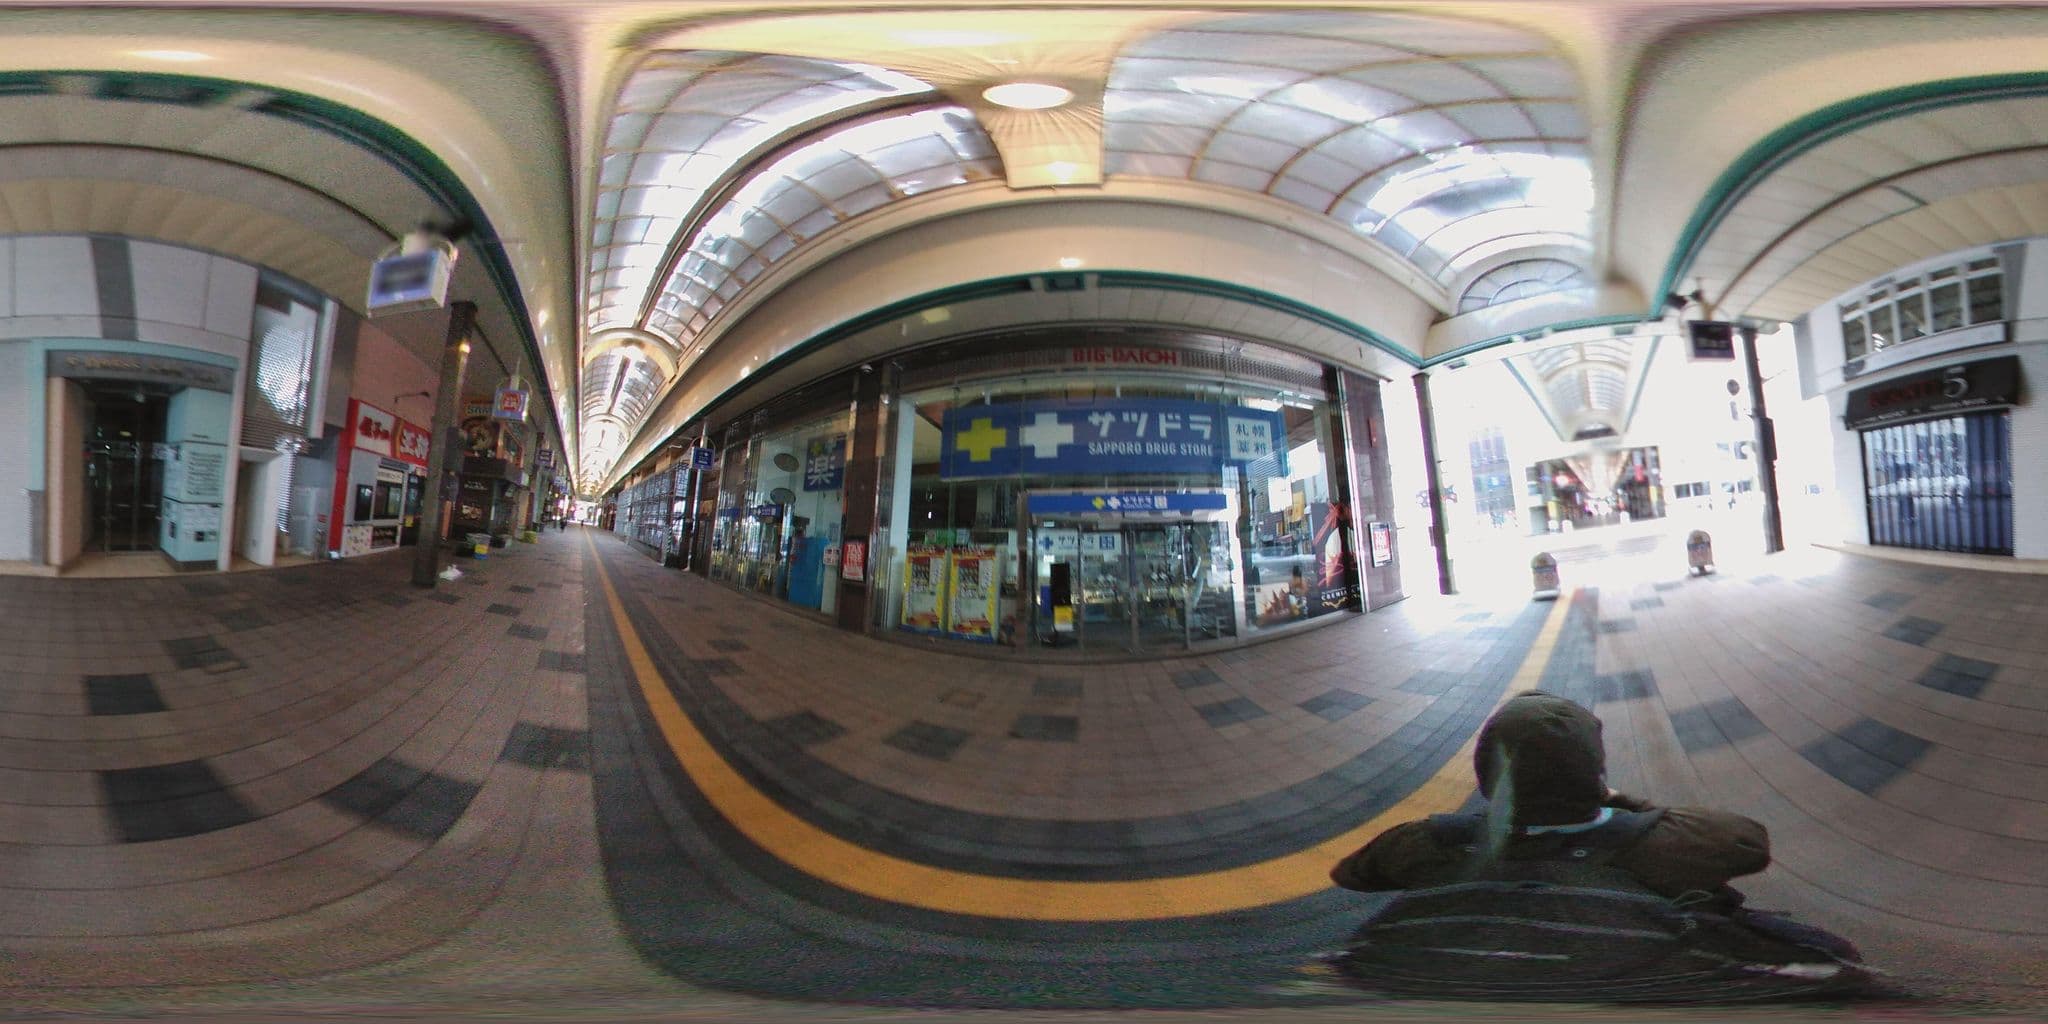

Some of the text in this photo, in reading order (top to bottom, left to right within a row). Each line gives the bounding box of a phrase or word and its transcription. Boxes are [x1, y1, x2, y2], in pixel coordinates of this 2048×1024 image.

[1088, 411, 1212, 441] サツドラ
[1088, 441, 1214, 457] SAPPORO DRUG STORE
